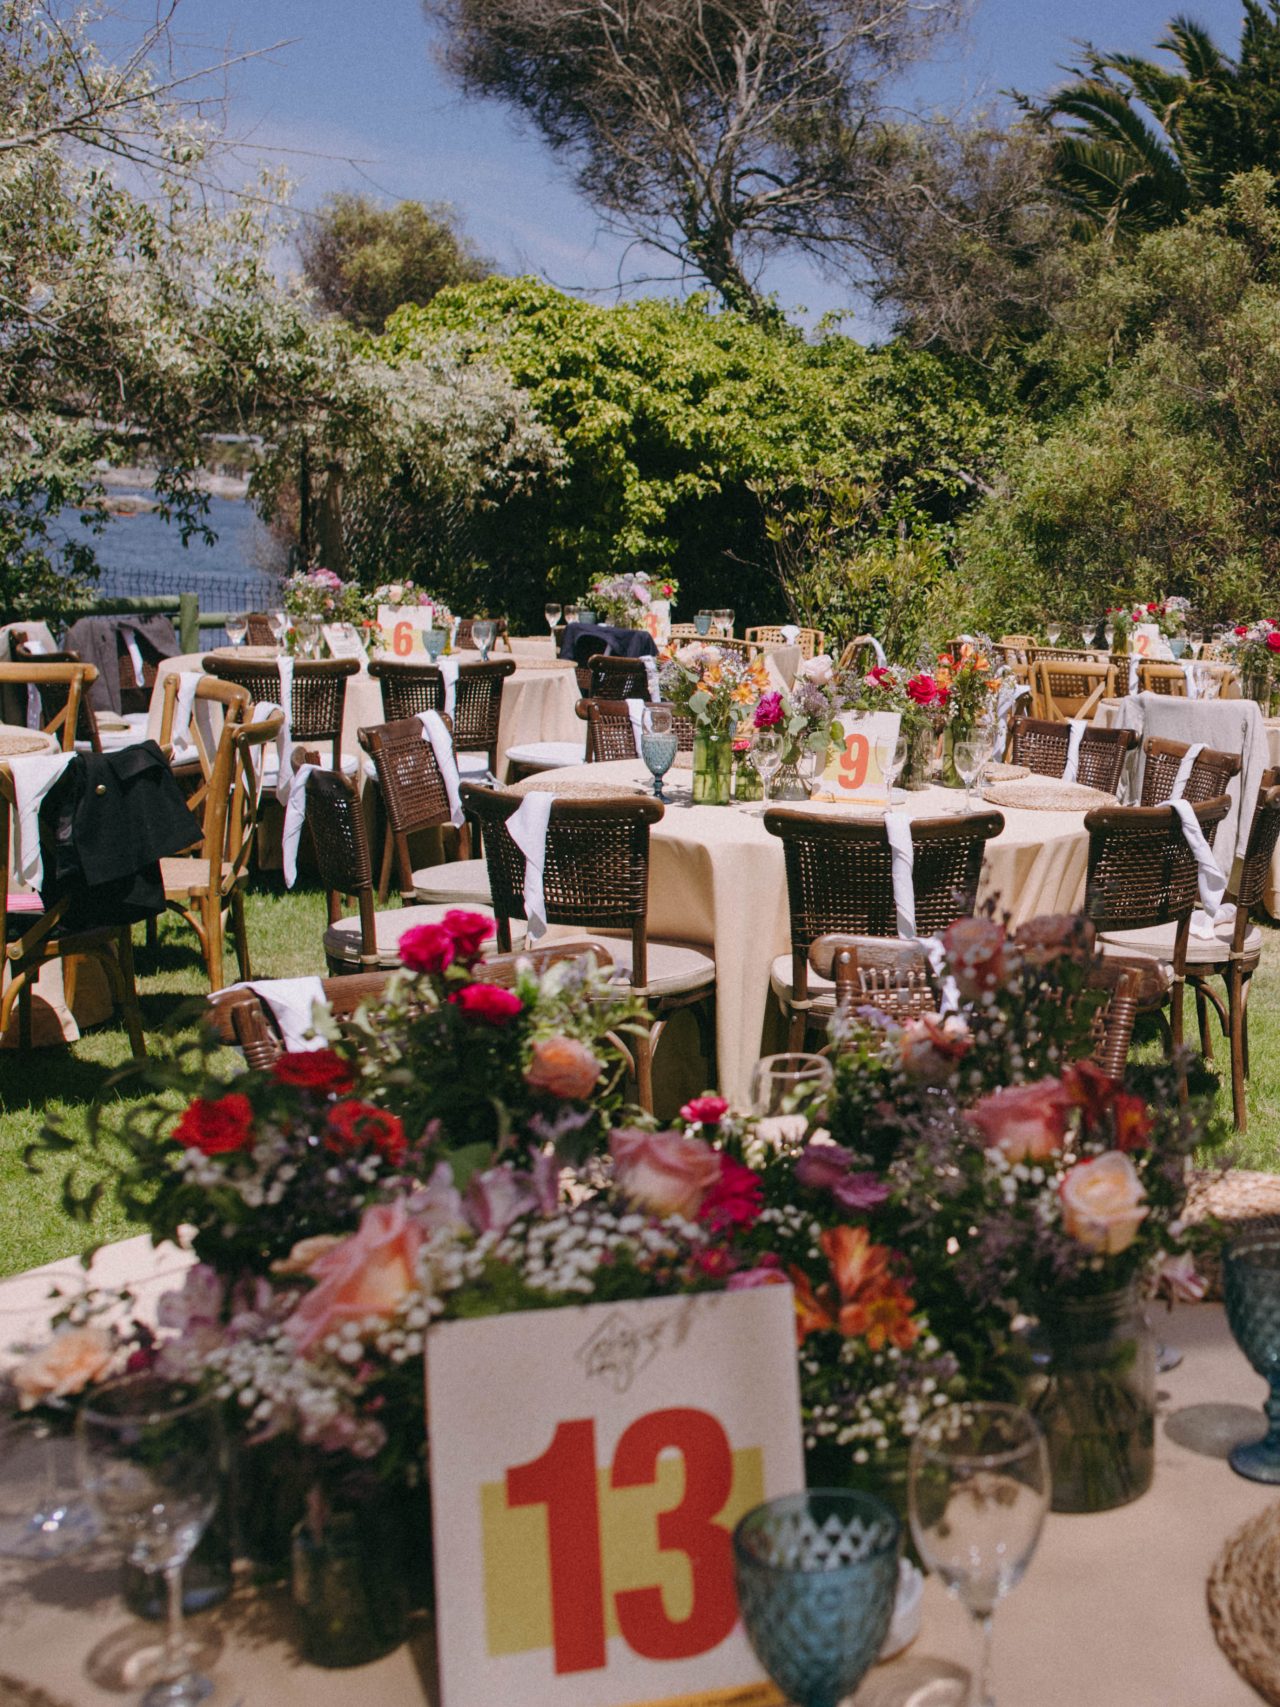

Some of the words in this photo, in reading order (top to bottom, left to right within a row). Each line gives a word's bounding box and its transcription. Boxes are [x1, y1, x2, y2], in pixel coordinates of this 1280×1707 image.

[393, 621, 413, 656] 6
[1136, 634, 1150, 658] 2
[838, 733, 870, 789] 9
[506, 1406, 741, 1676] 13
